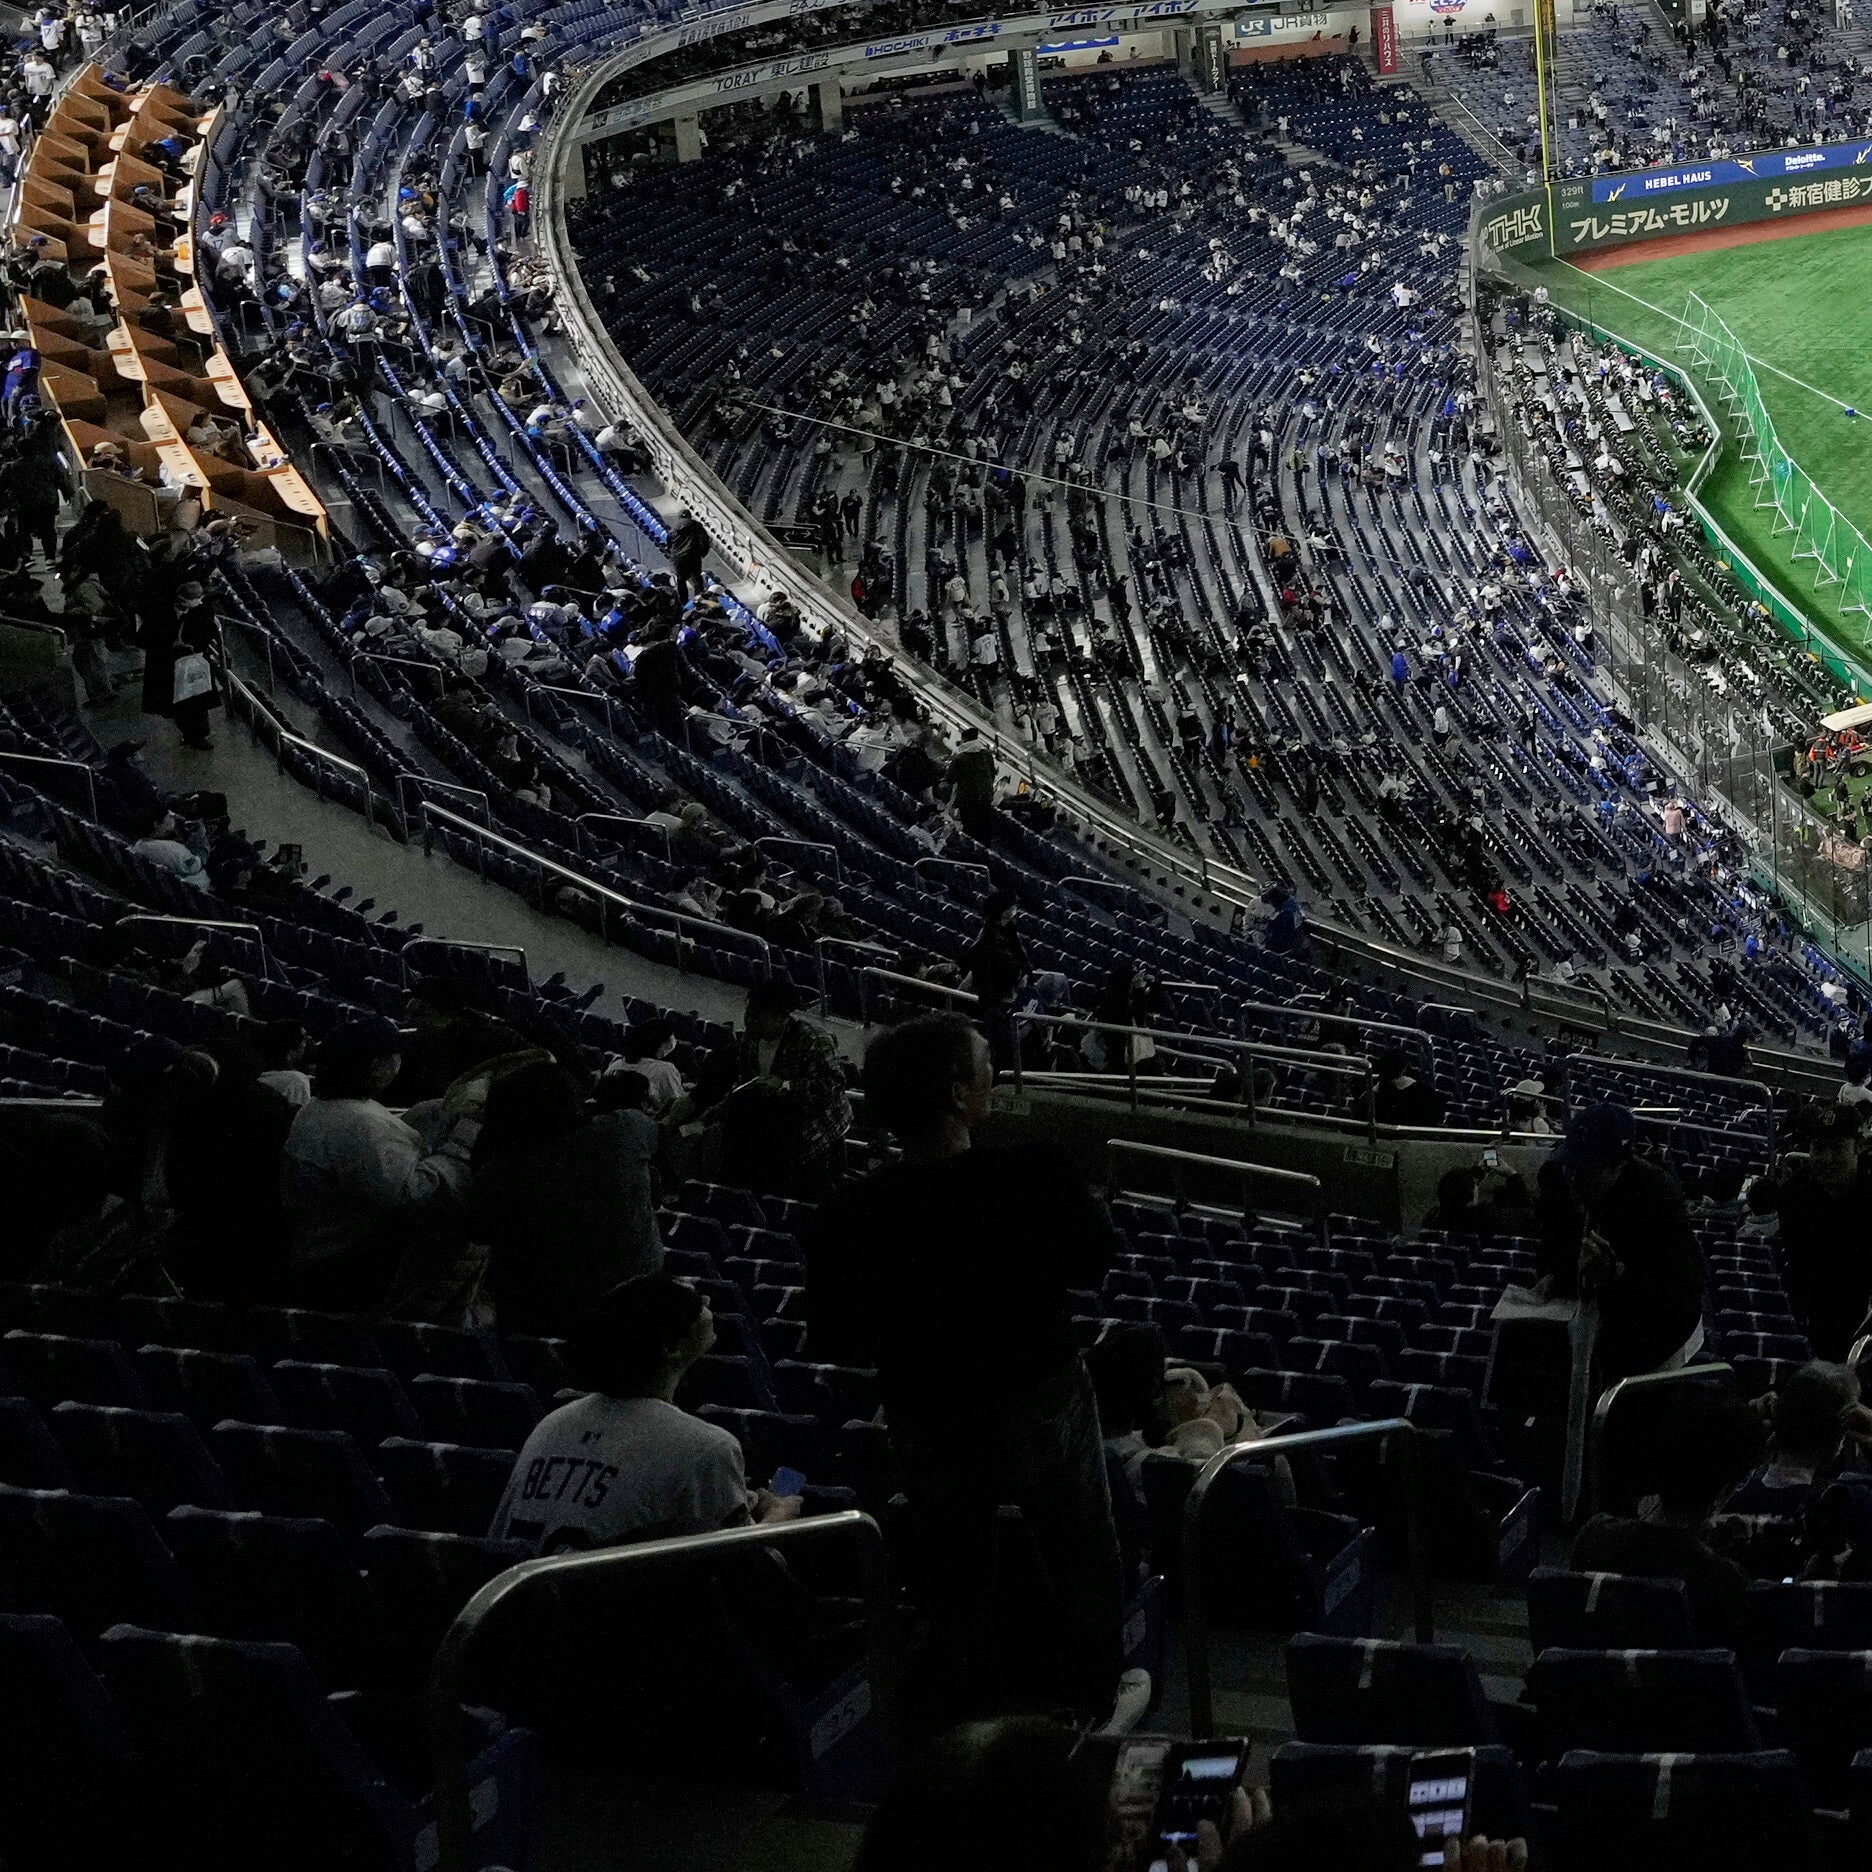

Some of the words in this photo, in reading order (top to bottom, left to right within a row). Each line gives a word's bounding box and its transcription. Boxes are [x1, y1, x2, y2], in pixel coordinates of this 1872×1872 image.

[1785, 153, 1826, 166] Deloitte.
[1561, 187, 1584, 198] 329ft
[1645, 174, 1681, 190] HEBEL
[1682, 171, 1711, 185] HAUS
[1488, 204, 1542, 247] THK
[1571, 199, 1730, 243] プレミアム・モルツ
[522, 1456, 619, 1508] BETTS
